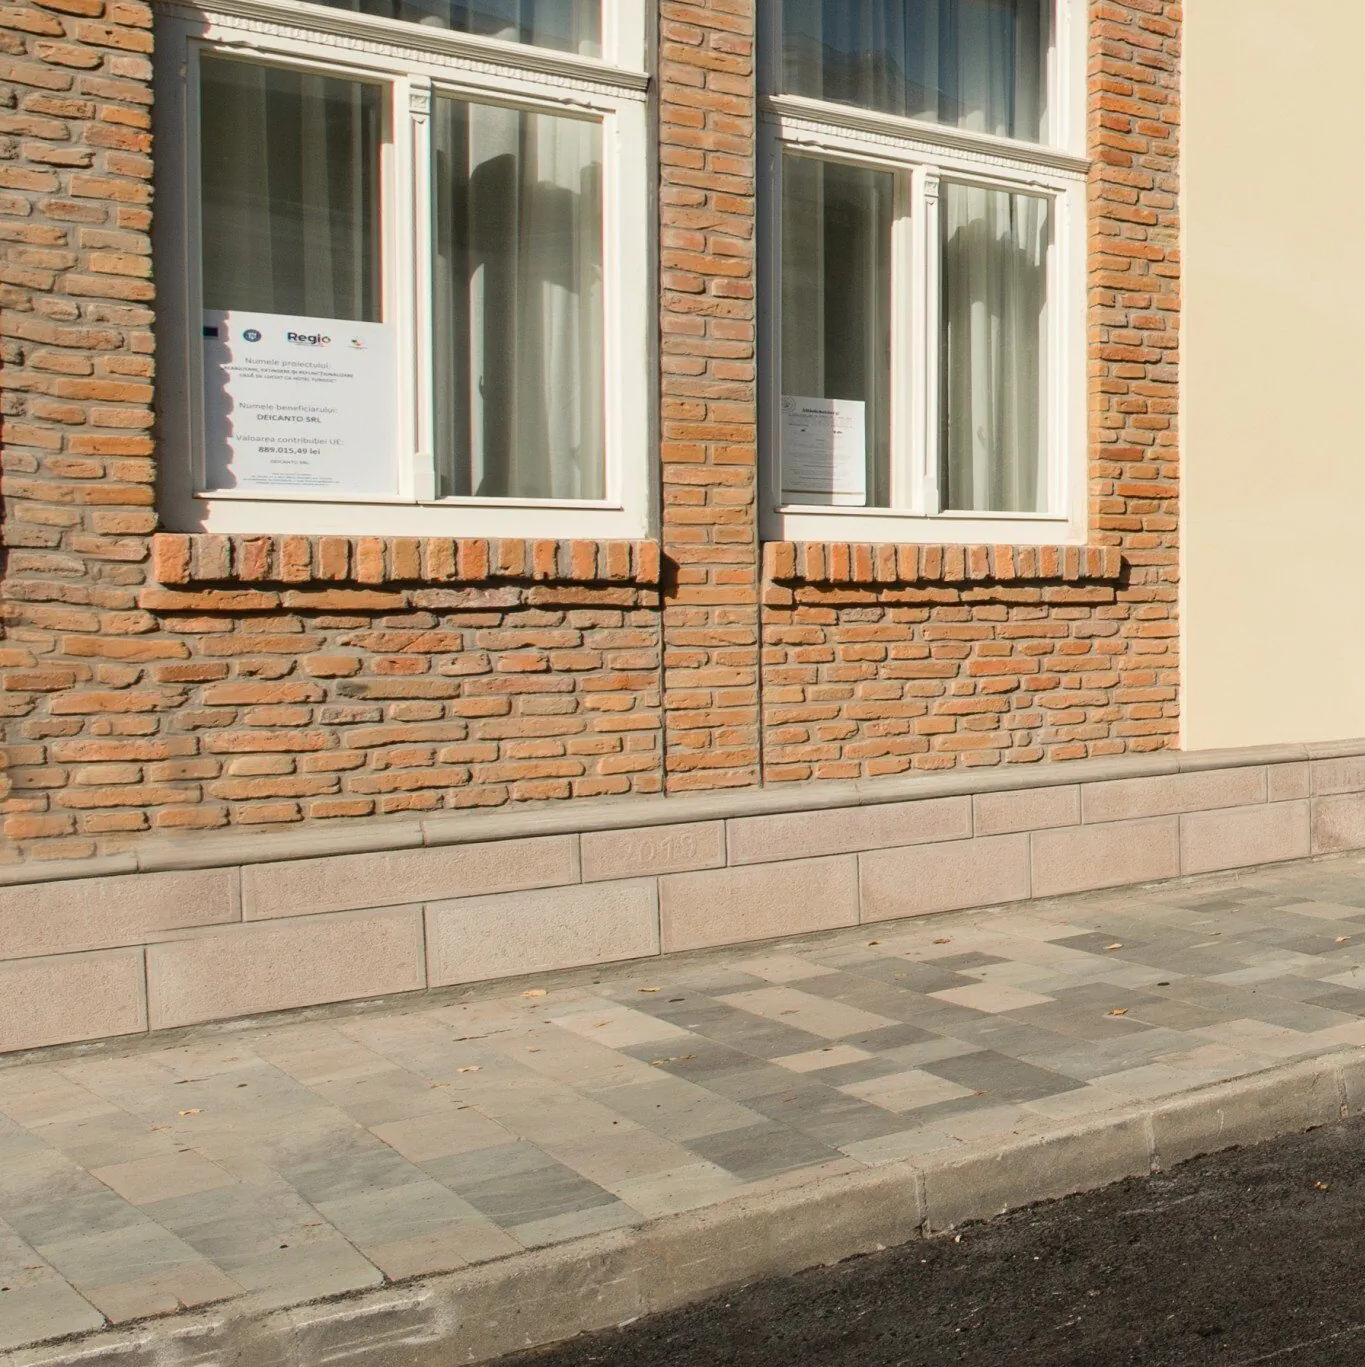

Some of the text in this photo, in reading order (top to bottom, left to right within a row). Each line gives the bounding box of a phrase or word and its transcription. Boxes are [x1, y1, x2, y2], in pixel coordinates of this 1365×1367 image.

[287, 332, 331, 344] Regio
[245, 357, 331, 369] Numele proiectului:
[239, 402, 338, 413] Numele beneficiarului:
[256, 414, 303, 422] DEICANTO
[236, 435, 275, 443] Valoarea
